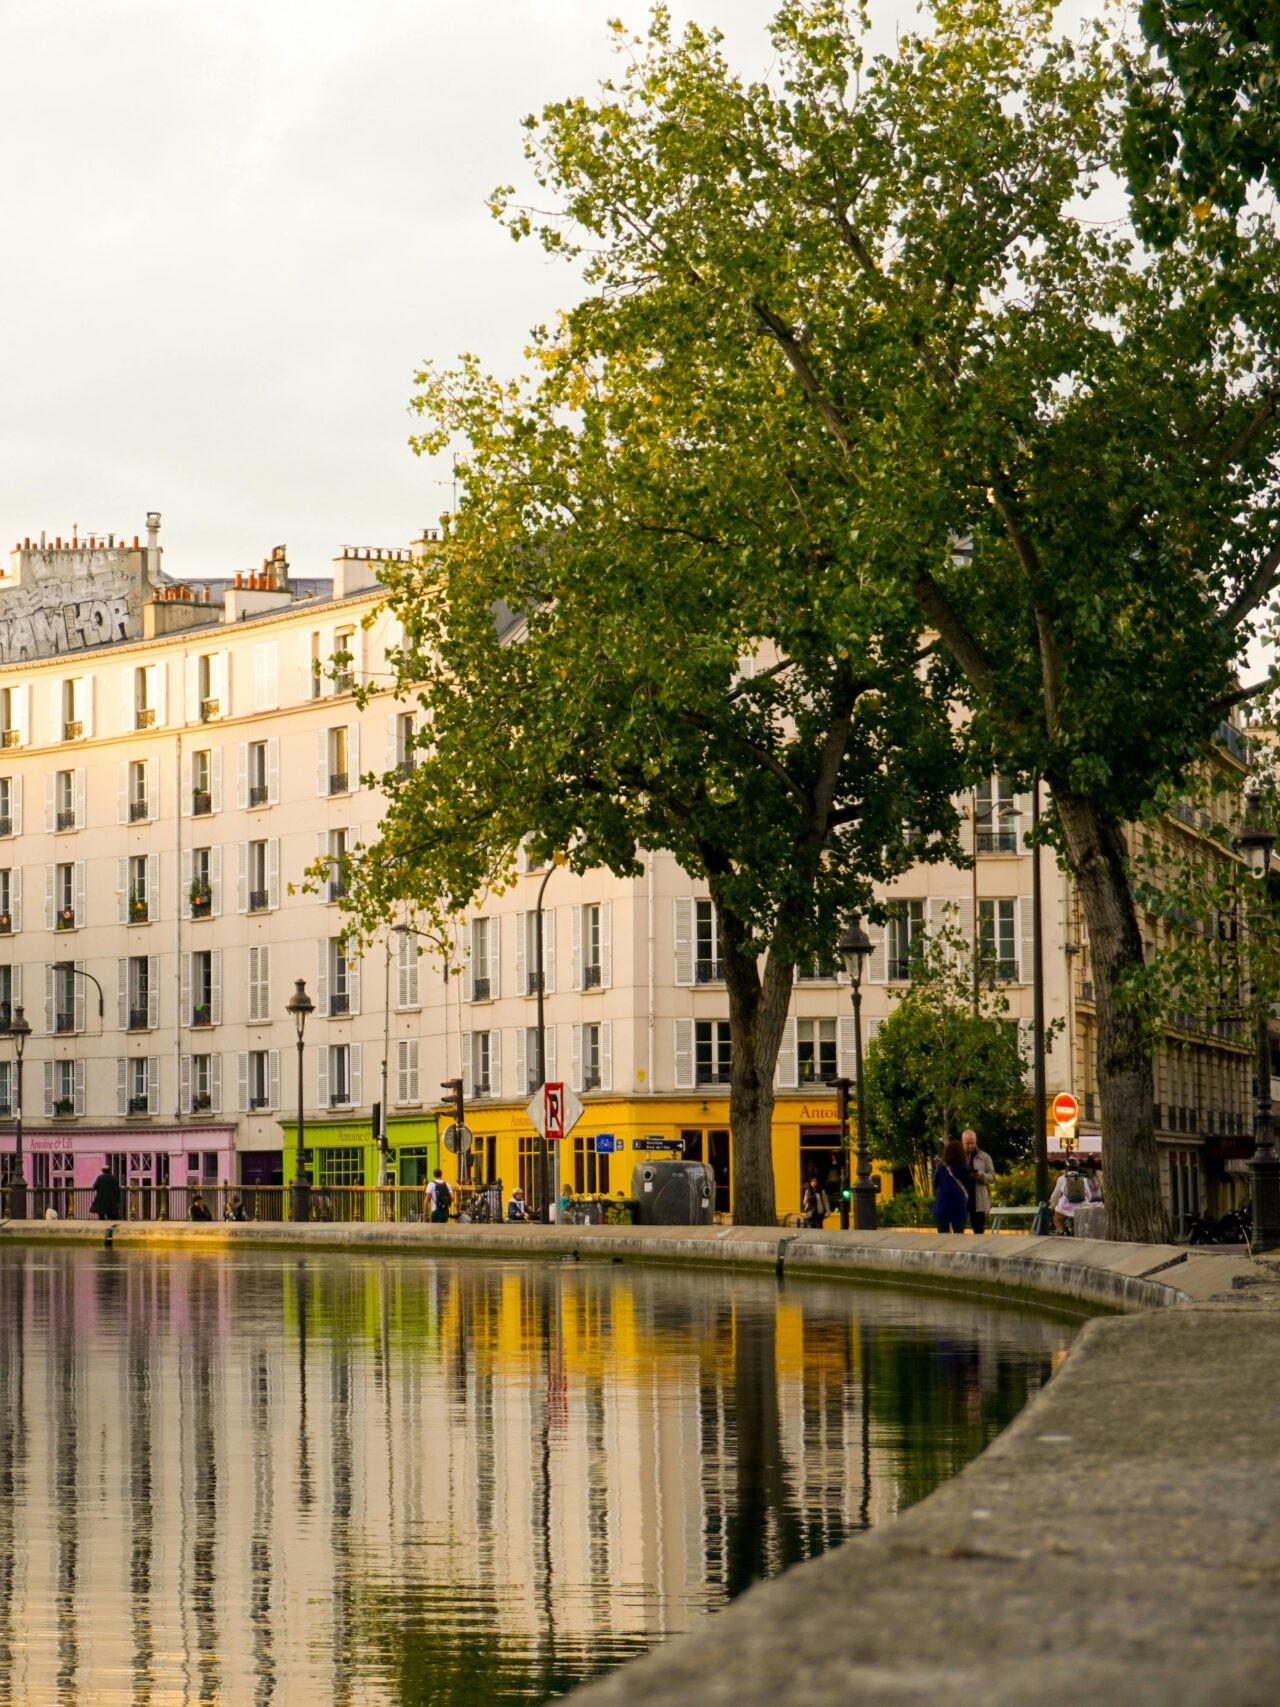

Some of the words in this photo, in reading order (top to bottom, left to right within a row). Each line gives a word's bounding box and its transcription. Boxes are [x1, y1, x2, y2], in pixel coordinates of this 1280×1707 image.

[800, 1104, 838, 1119] Antoi
[30, 1138, 54, 1150] Antoine
[54, 1137, 62, 1149] &
[62, 1137, 73, 1149] Lili
